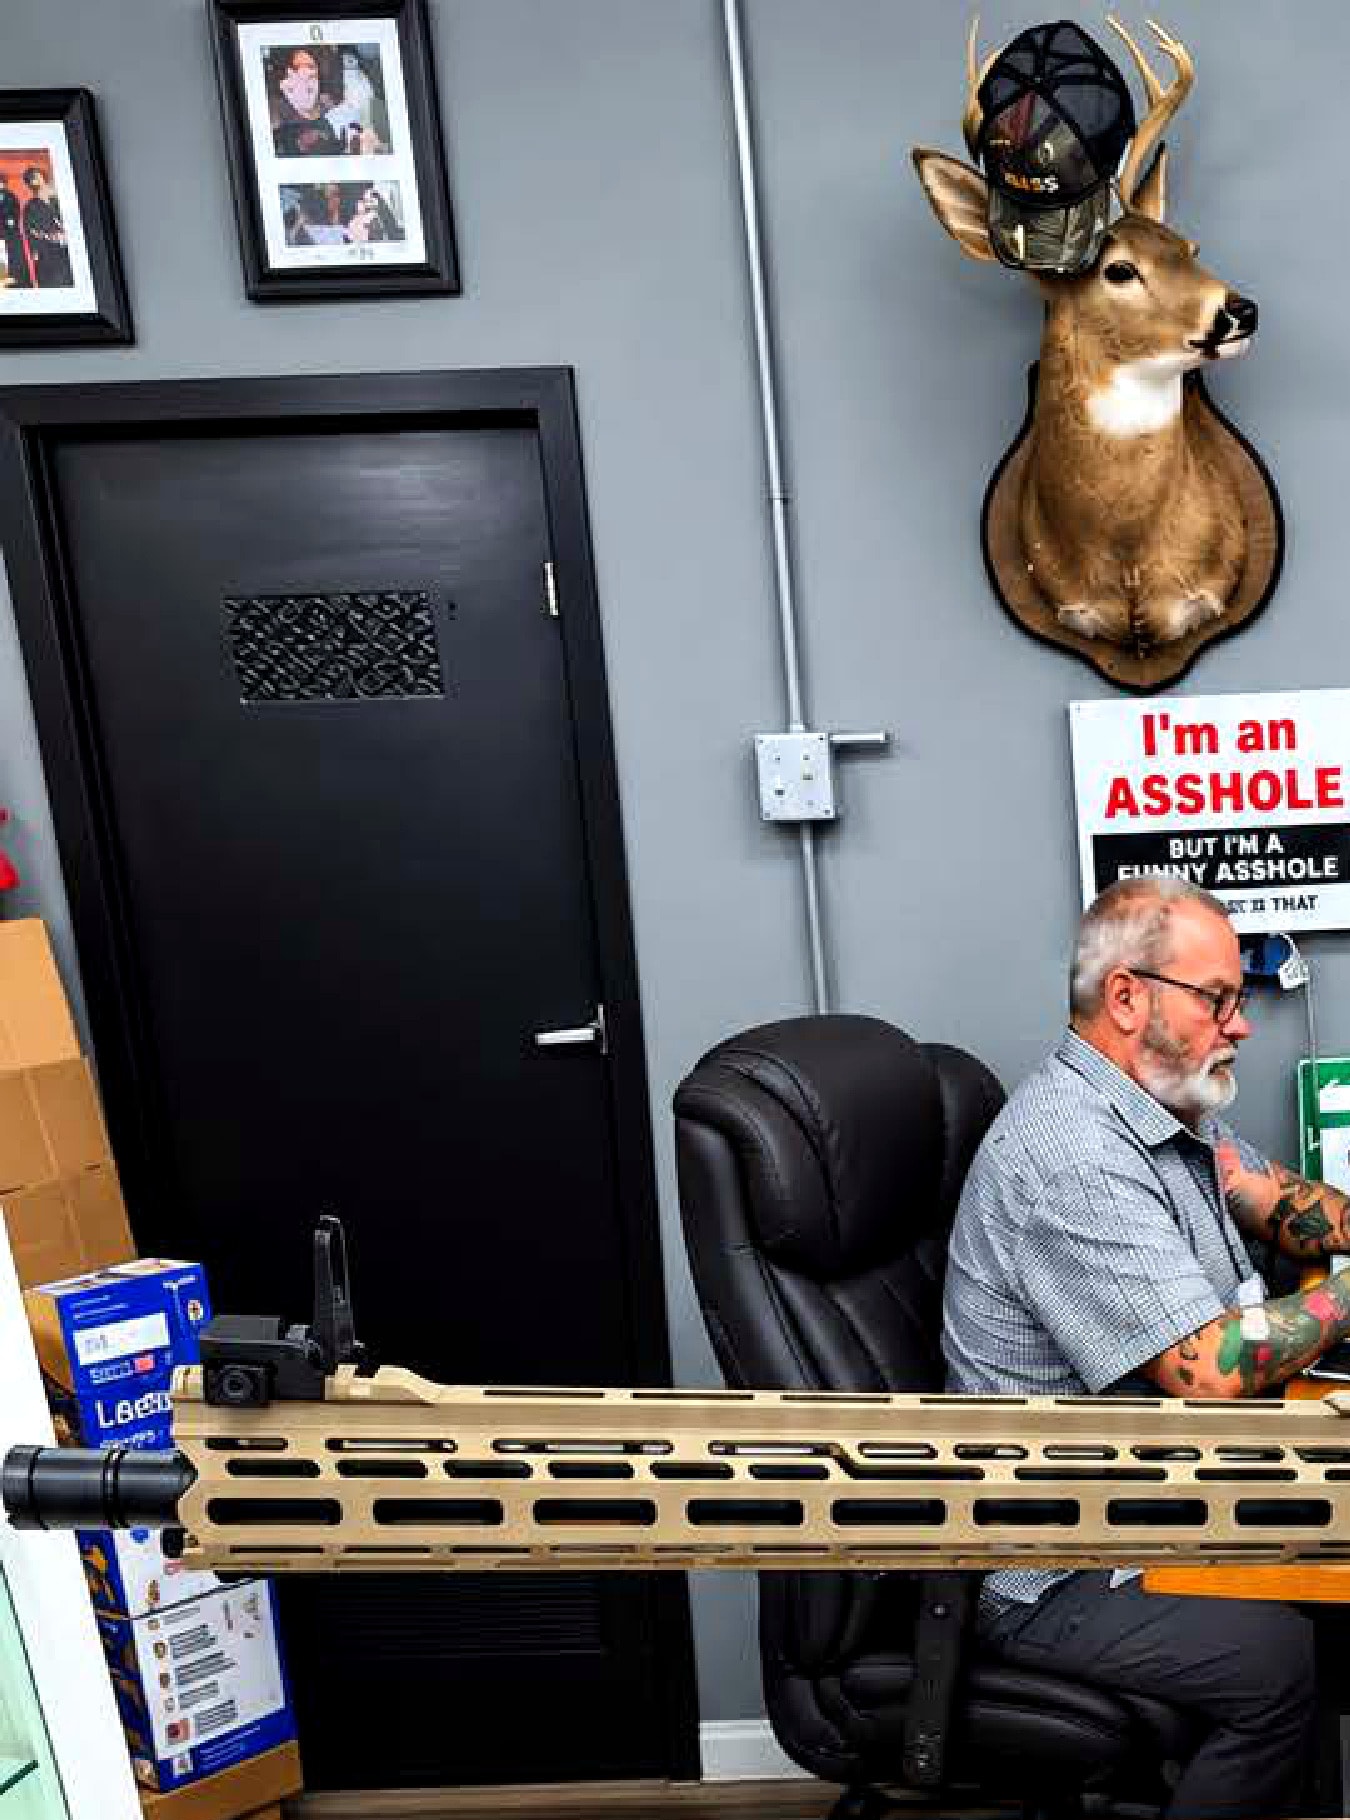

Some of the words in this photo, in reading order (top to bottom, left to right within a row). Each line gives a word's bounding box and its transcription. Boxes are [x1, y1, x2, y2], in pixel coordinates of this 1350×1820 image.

[1142, 713, 1219, 757] I'm
[1237, 717, 1297, 752] an
[1104, 766, 1344, 818] ASSHOLE
[1169, 837, 1218, 858] BUT
[1224, 834, 1258, 854] I'M
[1266, 832, 1284, 853] A
[1216, 855, 1339, 881] ASSHOLE
[1270, 895, 1319, 910] THAT
